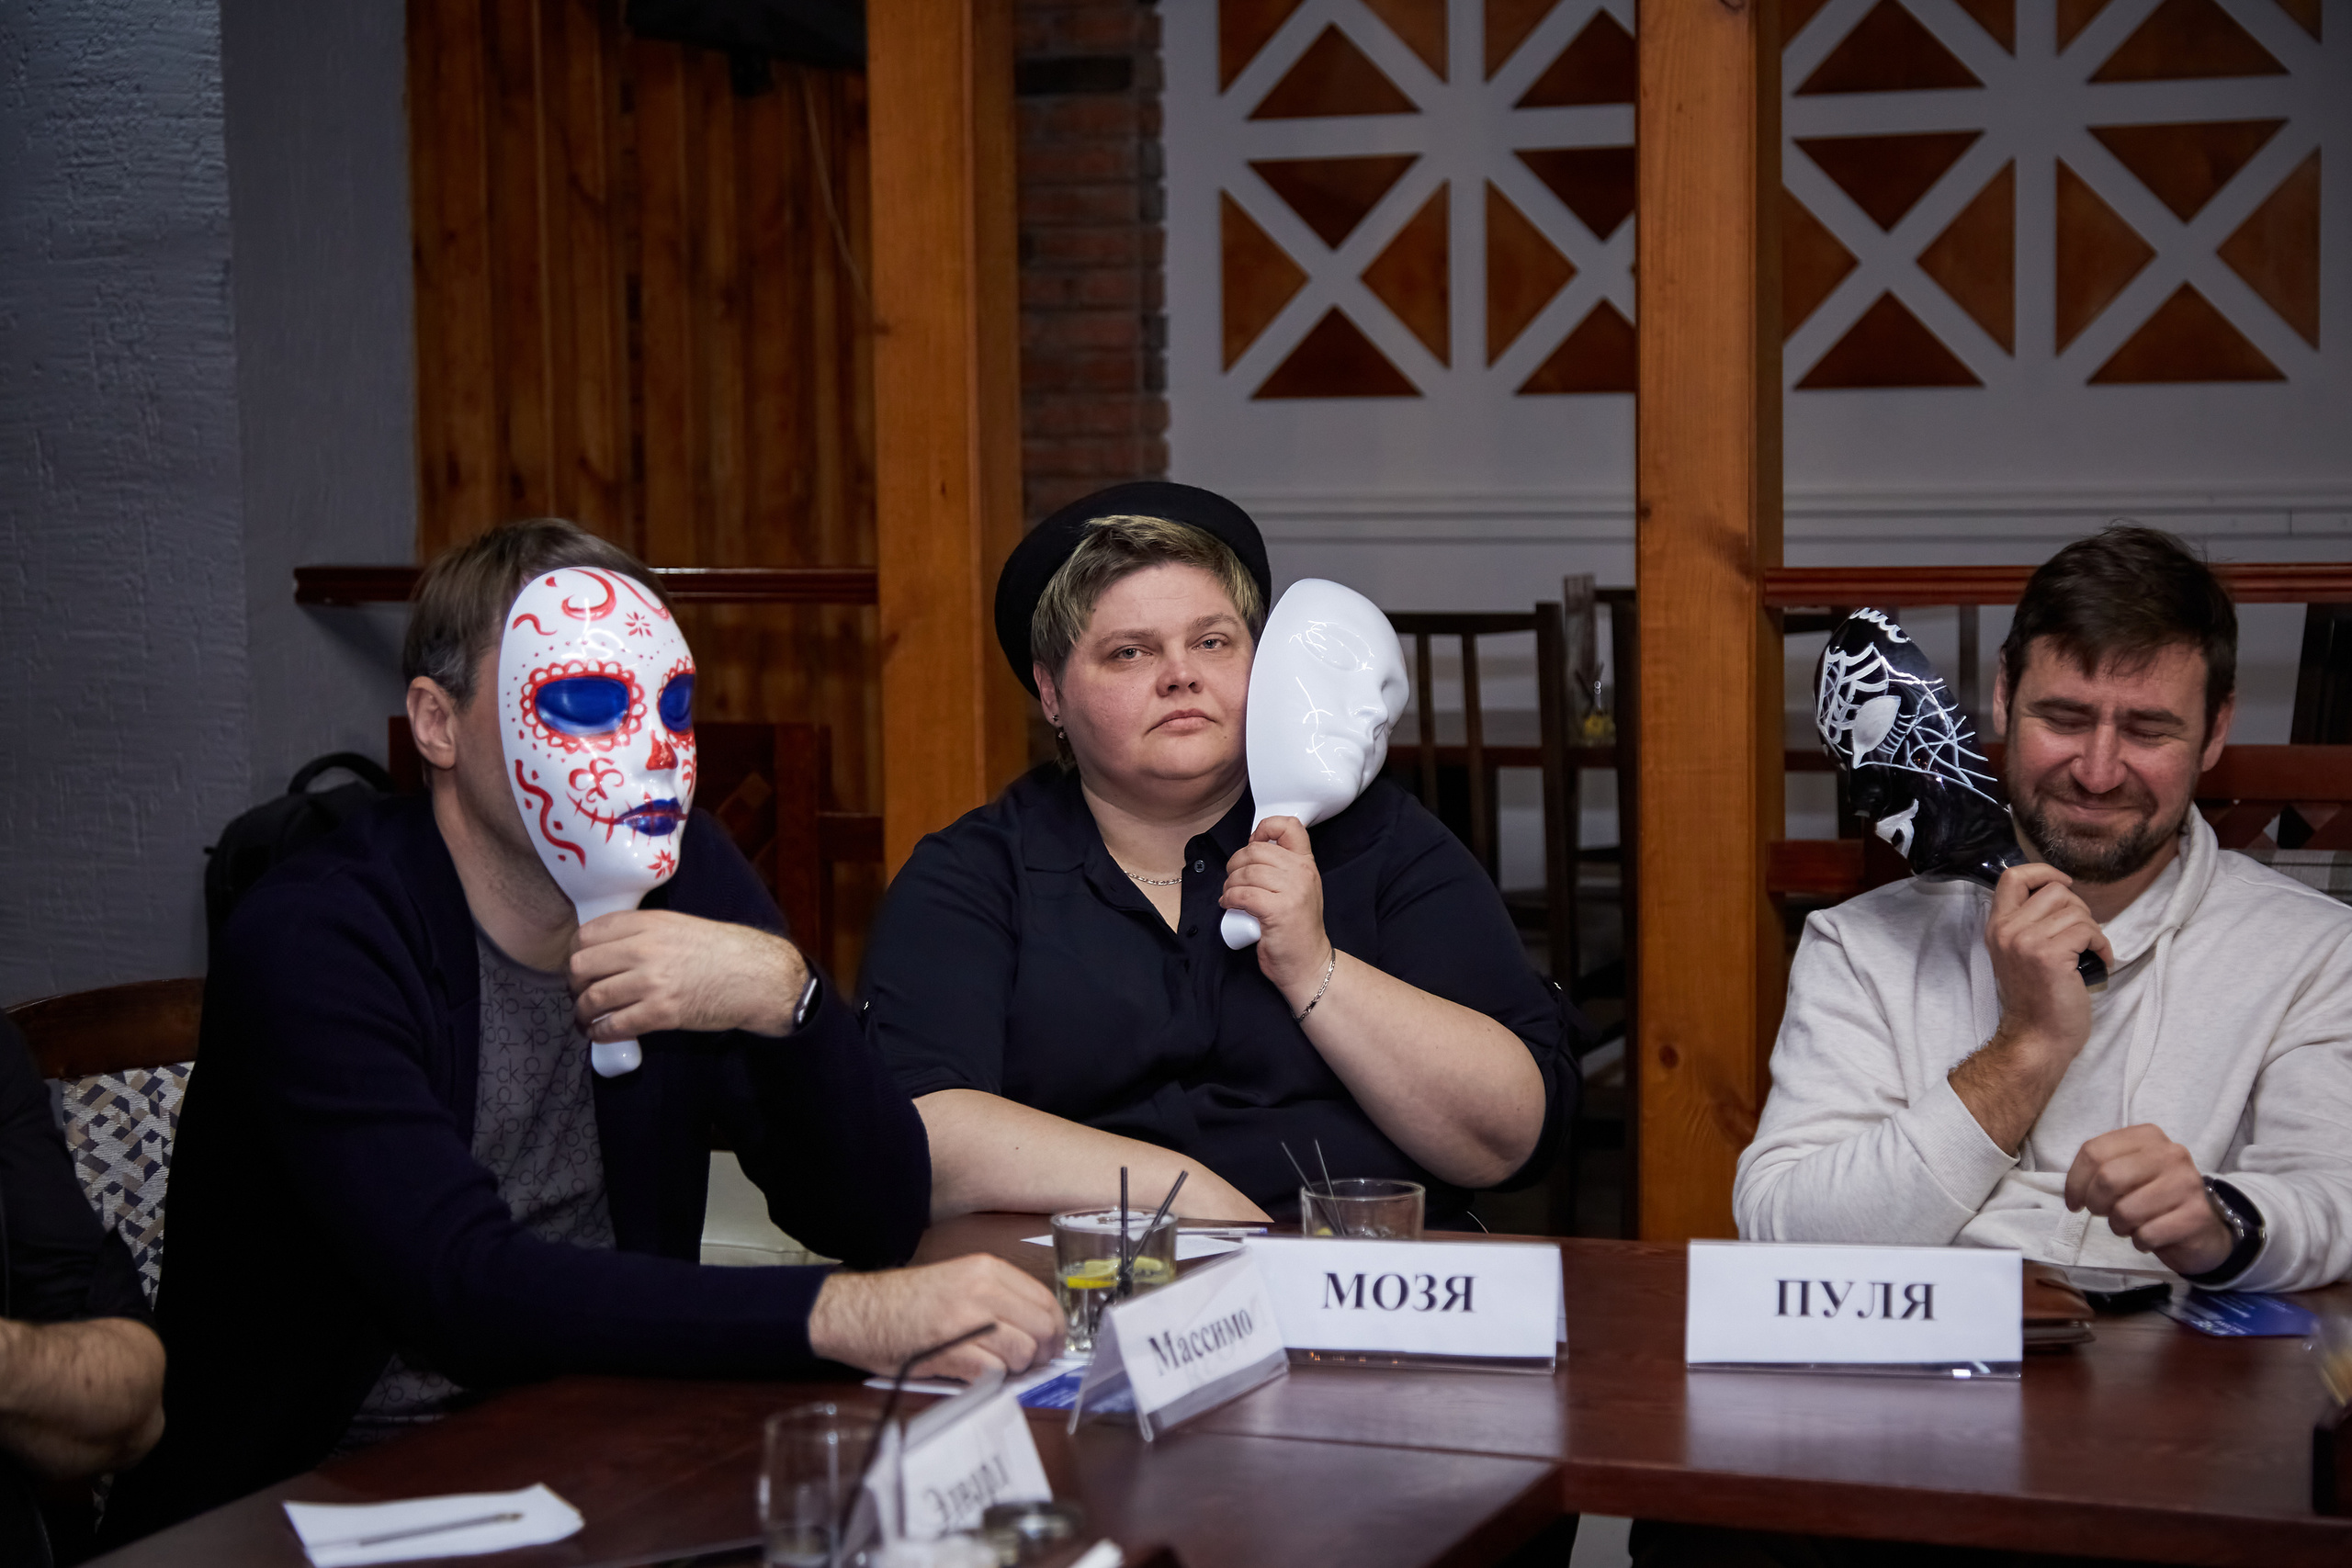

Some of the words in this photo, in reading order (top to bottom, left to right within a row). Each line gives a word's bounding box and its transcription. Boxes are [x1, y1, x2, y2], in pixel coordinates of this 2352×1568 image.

[496, 1057, 521, 1084] ck
[1321, 1270, 1478, 1313] МОЗЯ
[1774, 1279, 1938, 1320] ПУЛЯ
[1147, 1308, 1253, 1376] Массимо
